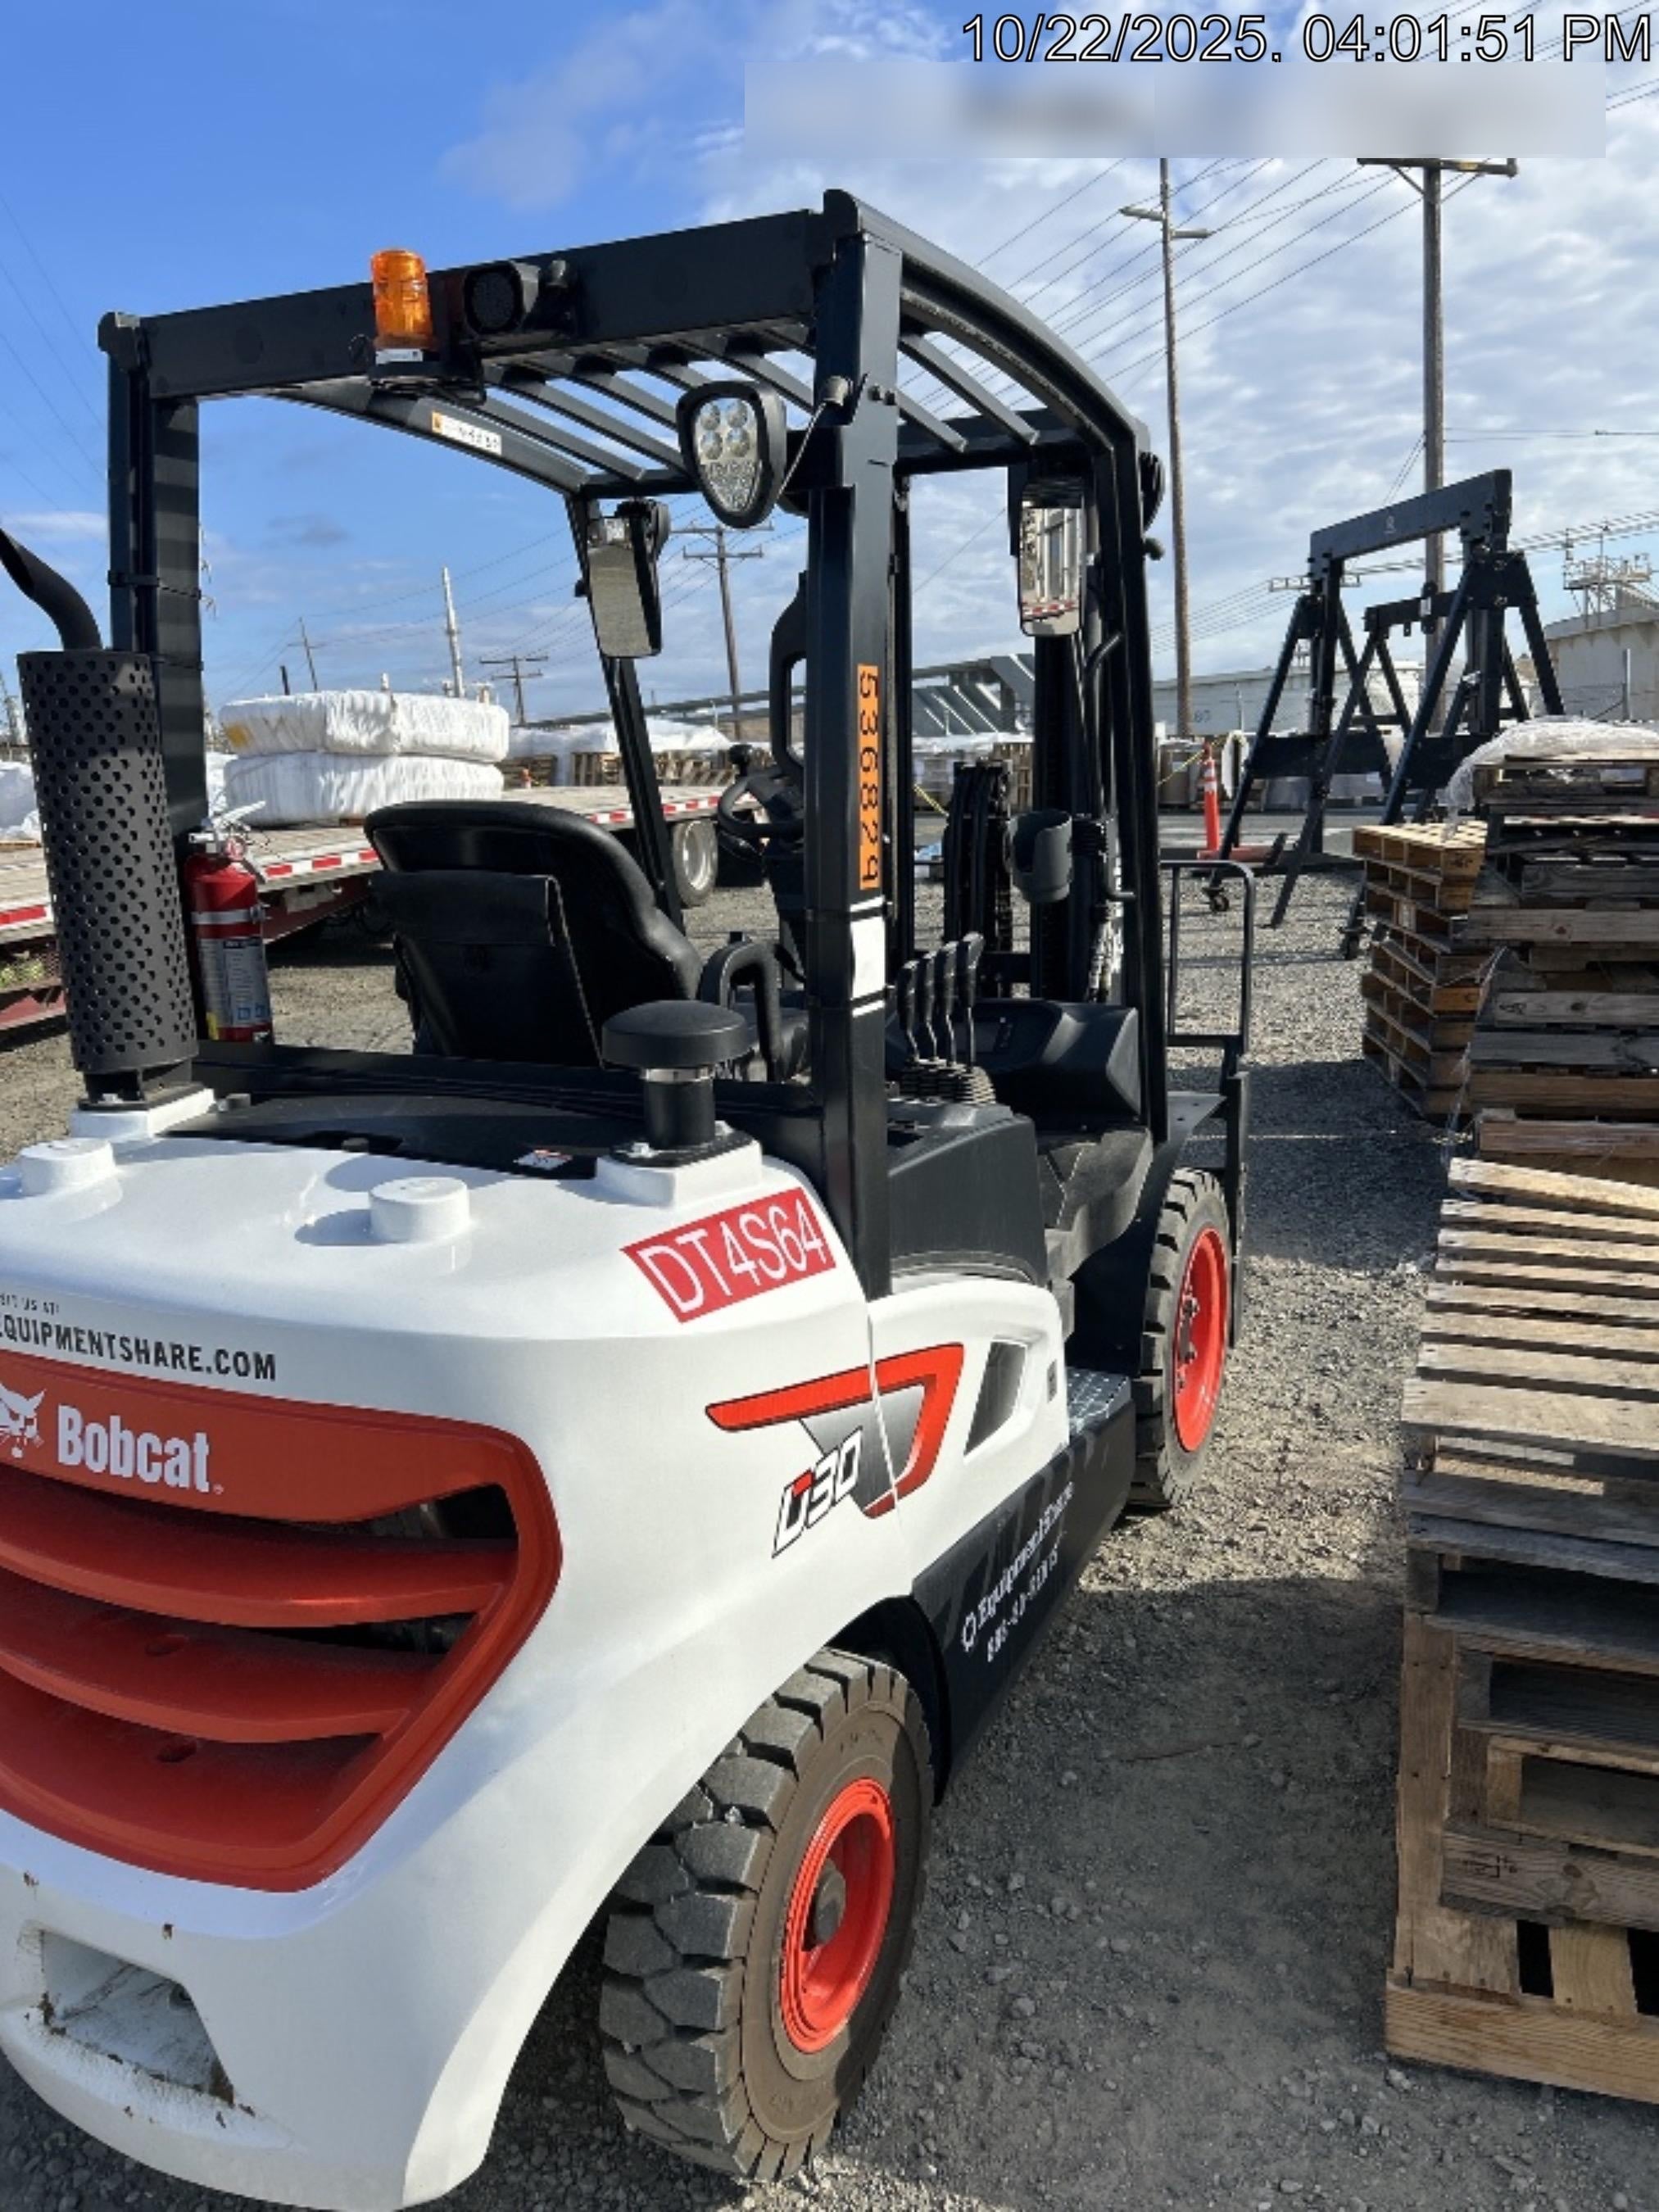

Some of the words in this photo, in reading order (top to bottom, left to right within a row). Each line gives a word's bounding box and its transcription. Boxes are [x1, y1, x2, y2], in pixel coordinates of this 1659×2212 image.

[637, 1199, 827, 1312] DT4S64
[0, 1314, 275, 1381] QUIPMENTSHARE.COM
[58, 1403, 210, 1493] Bobcat
[772, 1425, 863, 1559] D30
